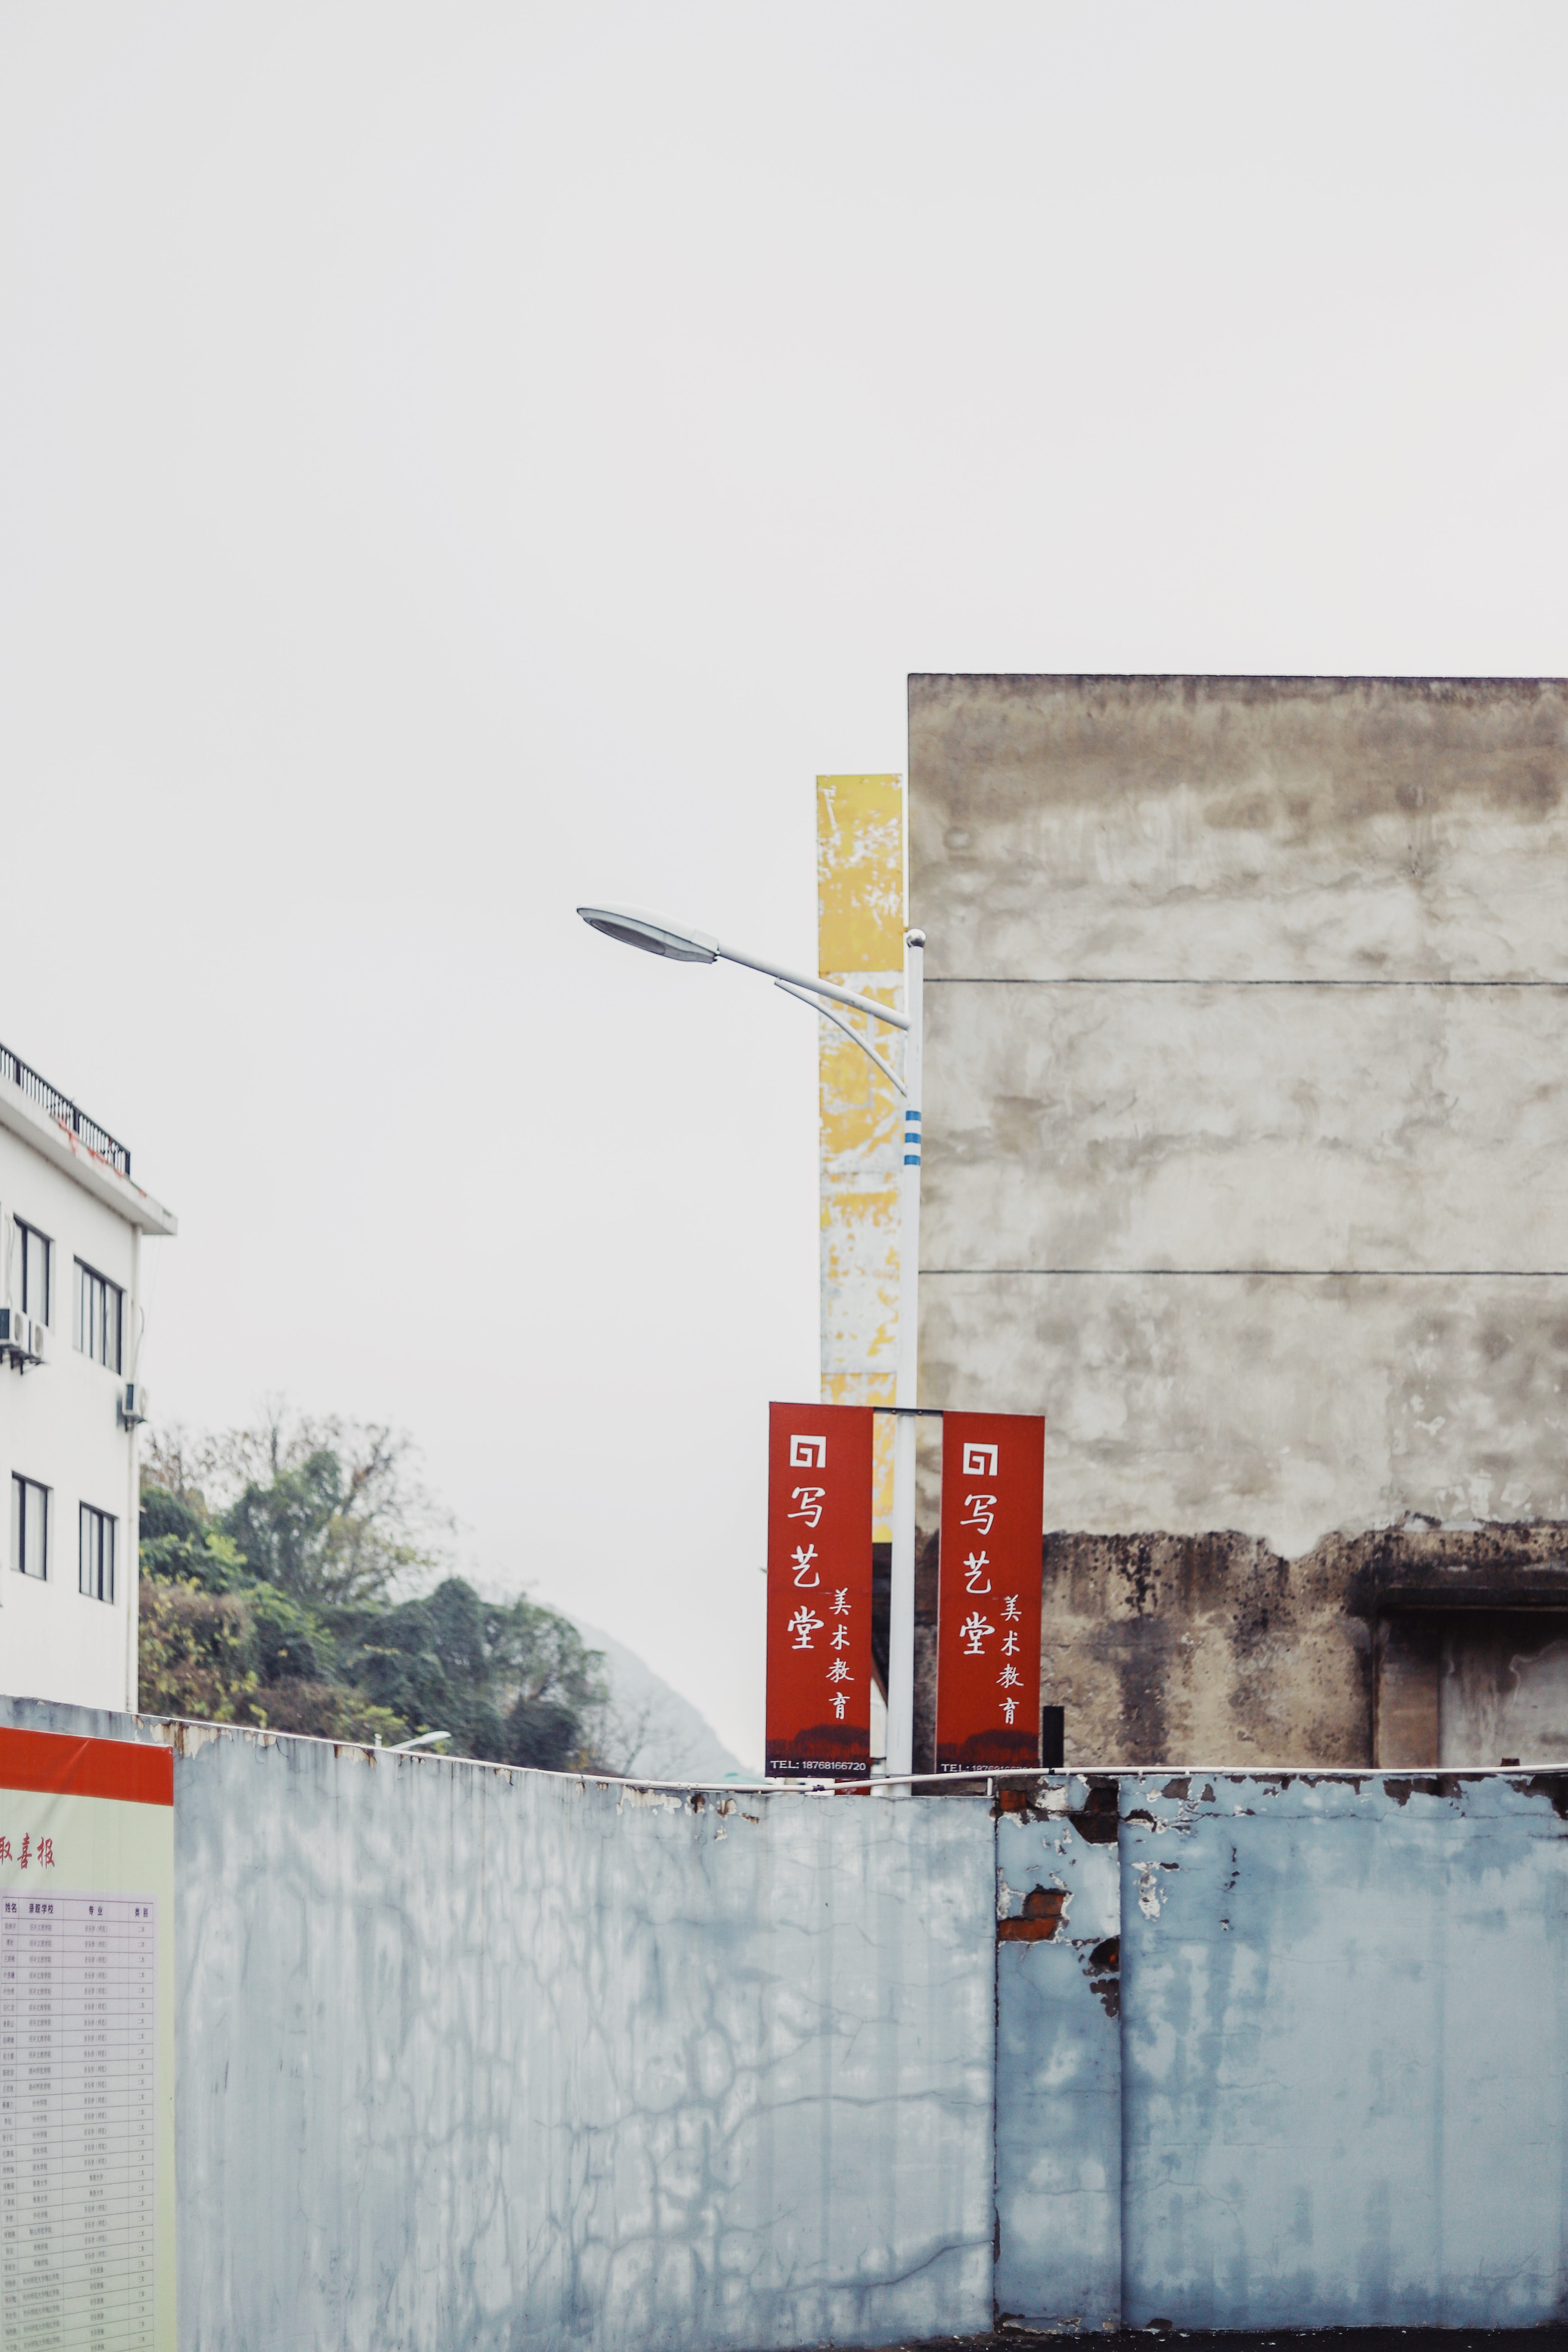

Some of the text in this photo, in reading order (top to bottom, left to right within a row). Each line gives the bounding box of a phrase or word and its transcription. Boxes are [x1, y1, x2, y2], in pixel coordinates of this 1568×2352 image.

[787, 1487, 825, 1650] 写艺堂
[960, 1494, 997, 1655] 写艺堂
[826, 1587, 854, 1720] 美术教育
[996, 1594, 1024, 1724] 美术教育
[770, 1760, 866, 1770] TEL: 18768166720
[5, 1902, 148, 1917] 姓名 录取学校 专业 类别
